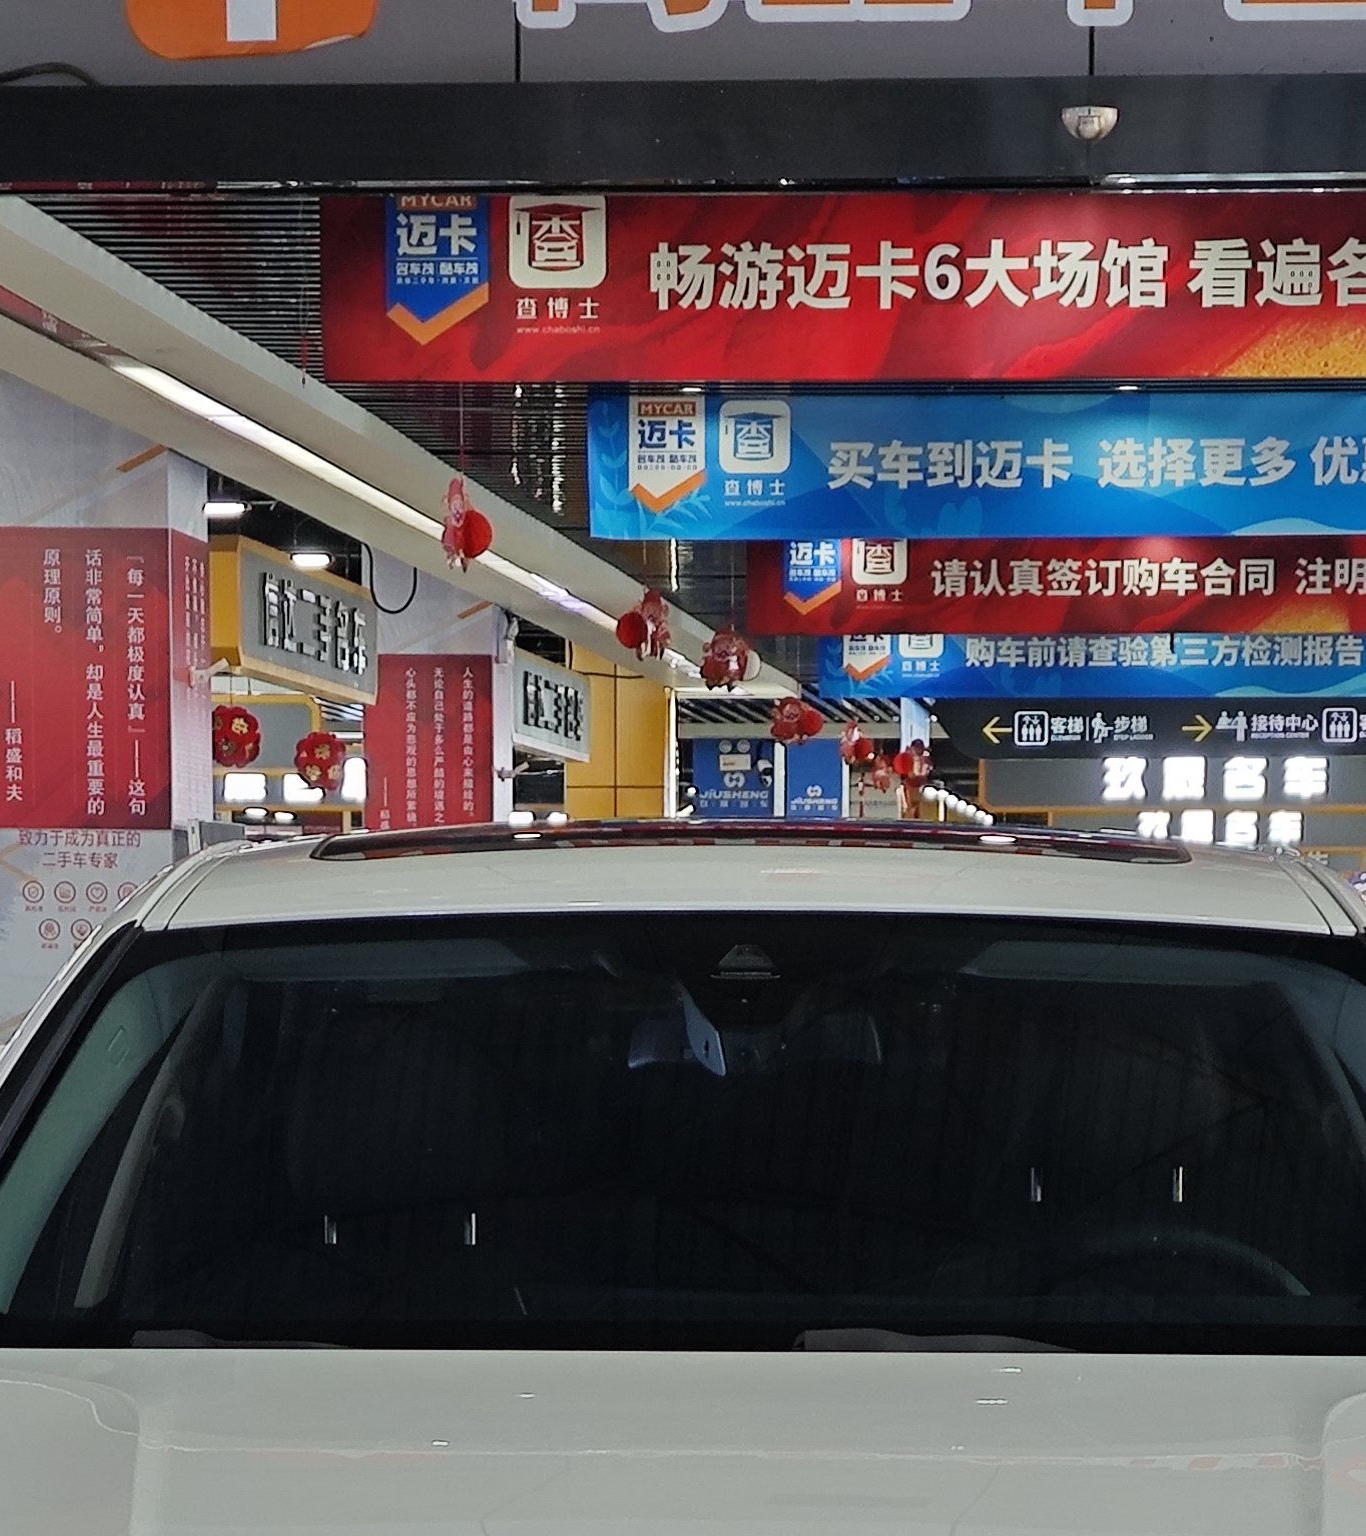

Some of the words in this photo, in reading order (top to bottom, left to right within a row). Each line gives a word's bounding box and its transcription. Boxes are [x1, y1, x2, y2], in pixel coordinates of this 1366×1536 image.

[396, 213, 477, 256] 迈卡
[649, 238, 1168, 311] 畅游迈卡6大场馆
[516, 296, 600, 319] 查博士
[641, 403, 695, 415] MYCAR
[638, 419, 696, 449] 迈卡
[827, 439, 1073, 490] 买车到迈卡
[1097, 435, 1297, 488] 选择更多
[724, 479, 785, 496] 查博士
[790, 541, 836, 566] 迈卡
[931, 556, 1275, 598] 请认真签订购车合同
[43, 547, 63, 635] 原理原则。
[965, 636, 1365, 668] 购车前请查验第三方检测报告
[84, 548, 105, 816] 话非常简单，却是人生最重要的
[1050, 716, 1084, 734] 客梯
[1113, 715, 1148, 733] 步梯
[1250, 713, 1319, 732] 接待中心
[19, 829, 141, 847] 致力于成为真正的
[42, 851, 119, 869] 二手车专家
